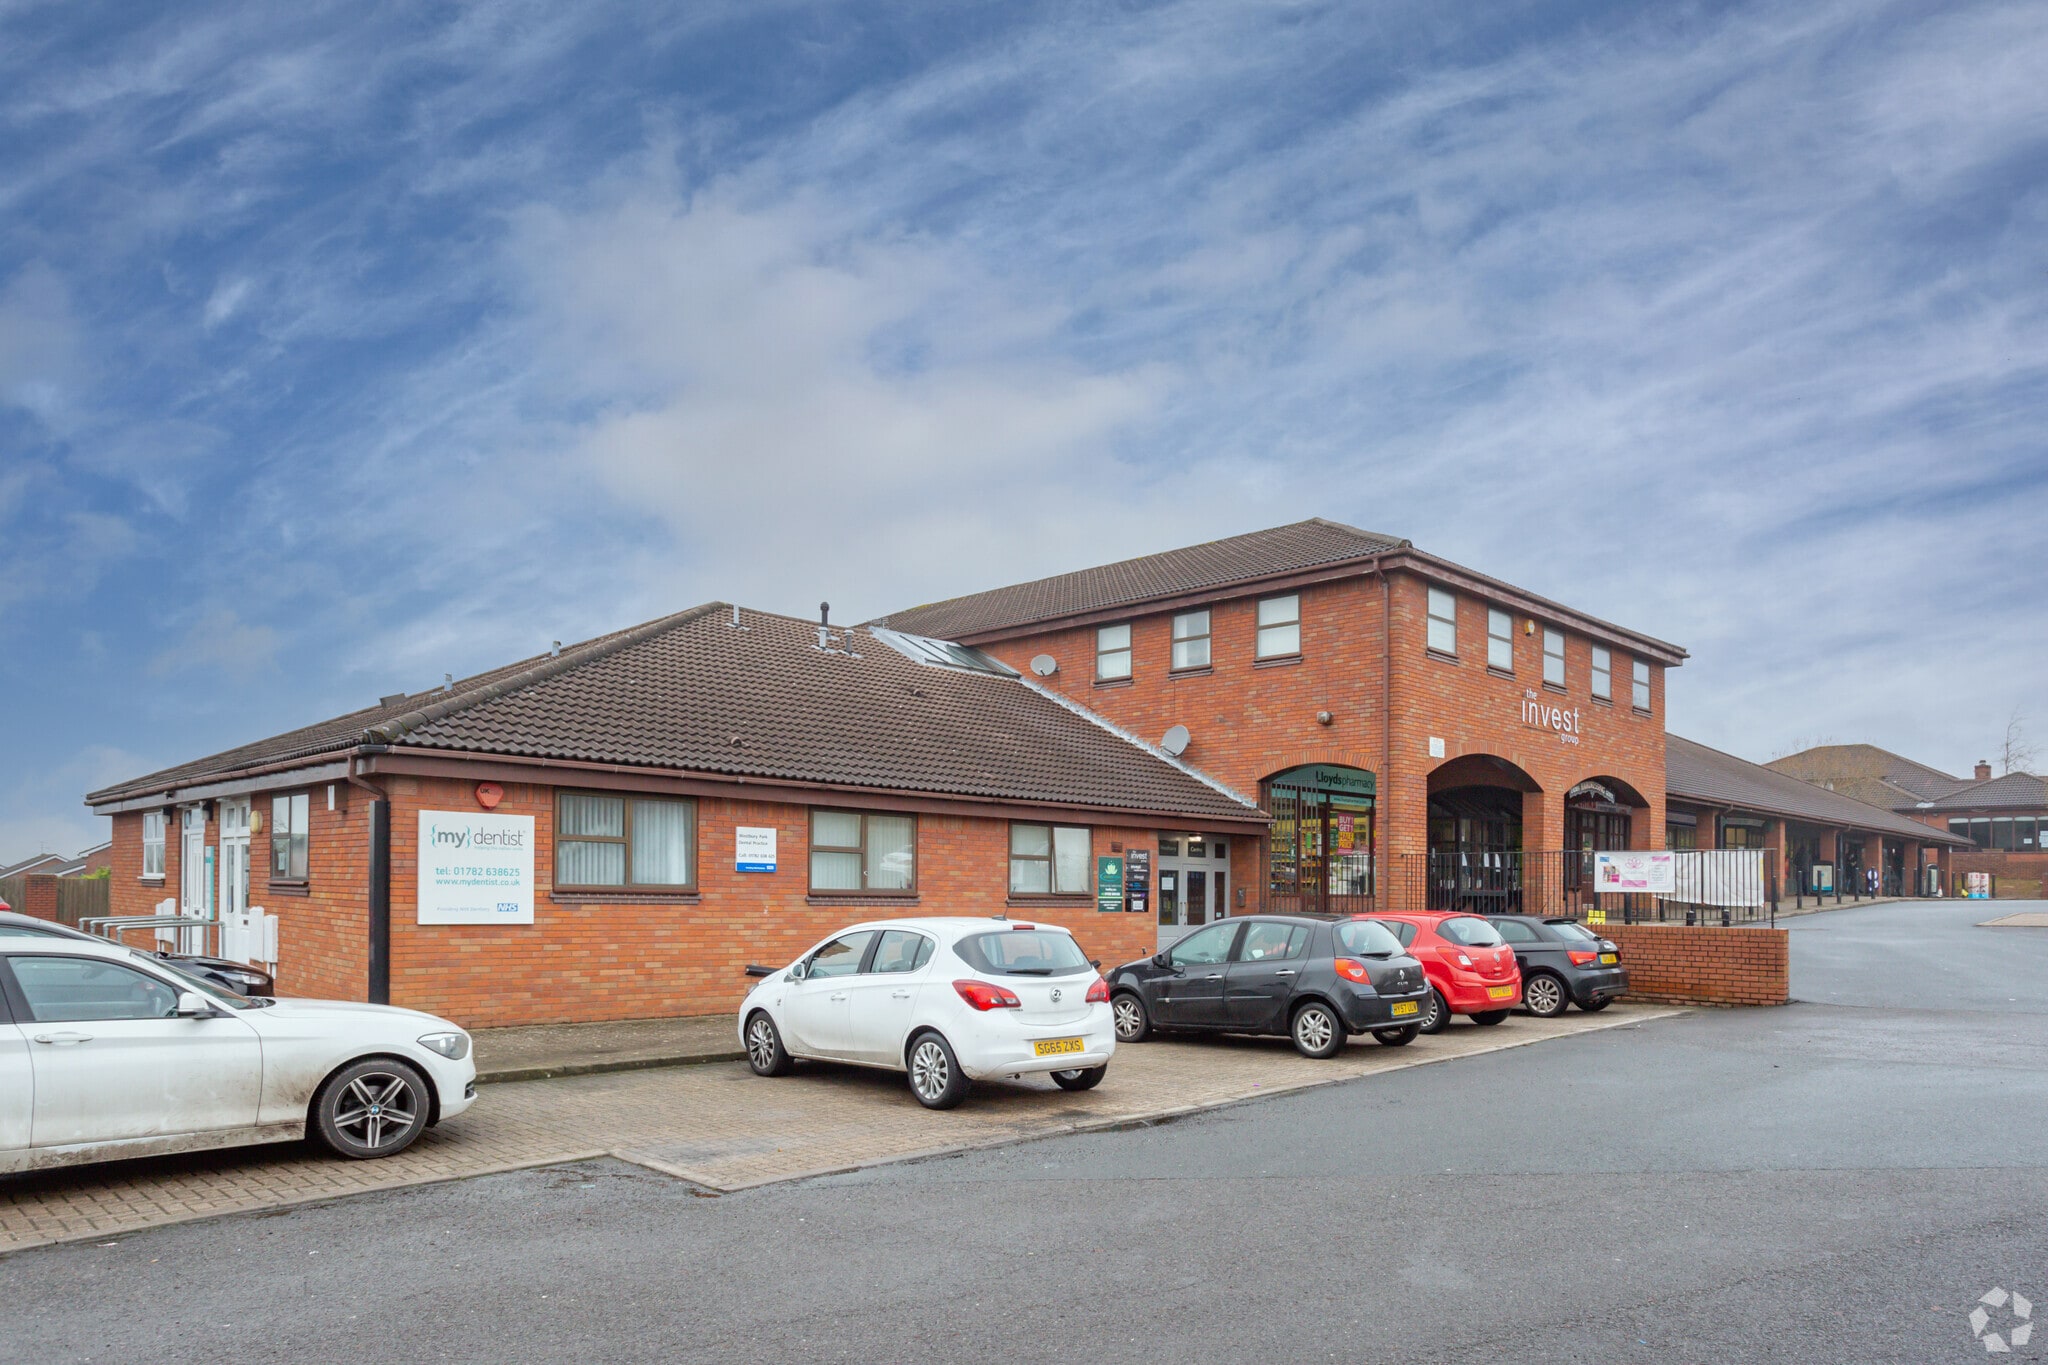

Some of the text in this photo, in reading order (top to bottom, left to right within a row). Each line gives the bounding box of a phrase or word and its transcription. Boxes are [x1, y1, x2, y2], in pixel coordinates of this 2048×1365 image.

[1526, 688, 1537, 700] the
[1522, 700, 1579, 734] invest
[474, 827, 523, 846] dentist
[435, 867, 520, 877] tel: 01782 638625
[435, 878, 520, 887] www.mydentist.co.uk
[498, 903, 517, 912] NHS
[1037, 1040, 1081, 1054] SG65 ZXS
